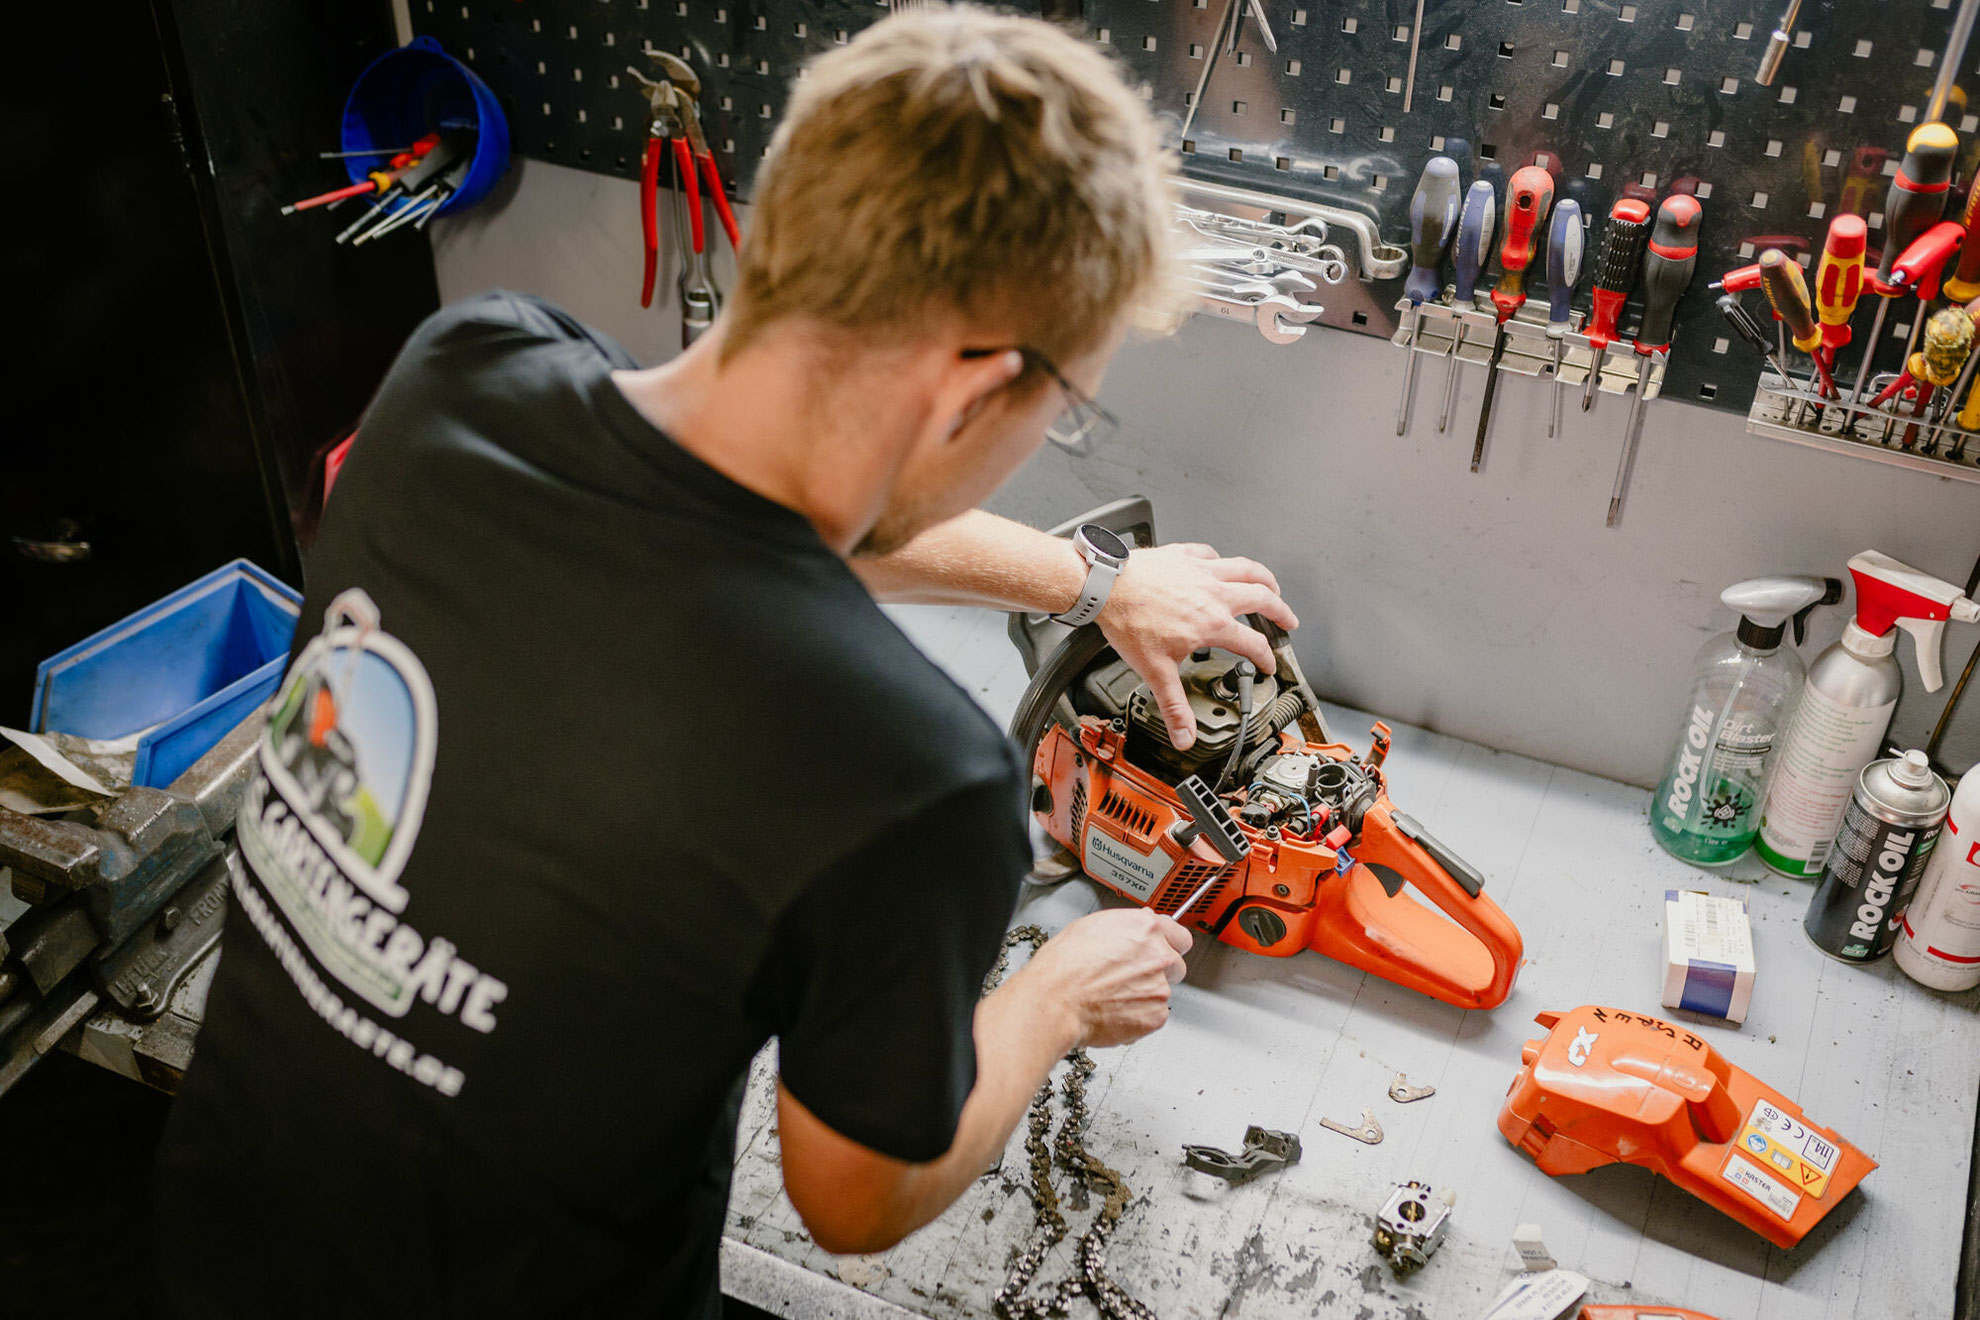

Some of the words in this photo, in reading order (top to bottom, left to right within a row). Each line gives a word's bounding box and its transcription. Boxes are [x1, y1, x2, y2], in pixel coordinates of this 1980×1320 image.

[1720, 730, 1776, 744] Blaster
[1723, 719, 1754, 733] Dirt
[1668, 743, 1702, 820] ROCK
[1688, 705, 1714, 749] OIL
[1103, 843, 1155, 880] Husqvarna
[1110, 869, 1146, 892] 357XP
[1850, 870, 1898, 941] ROCK
[1878, 832, 1916, 873] OIL
